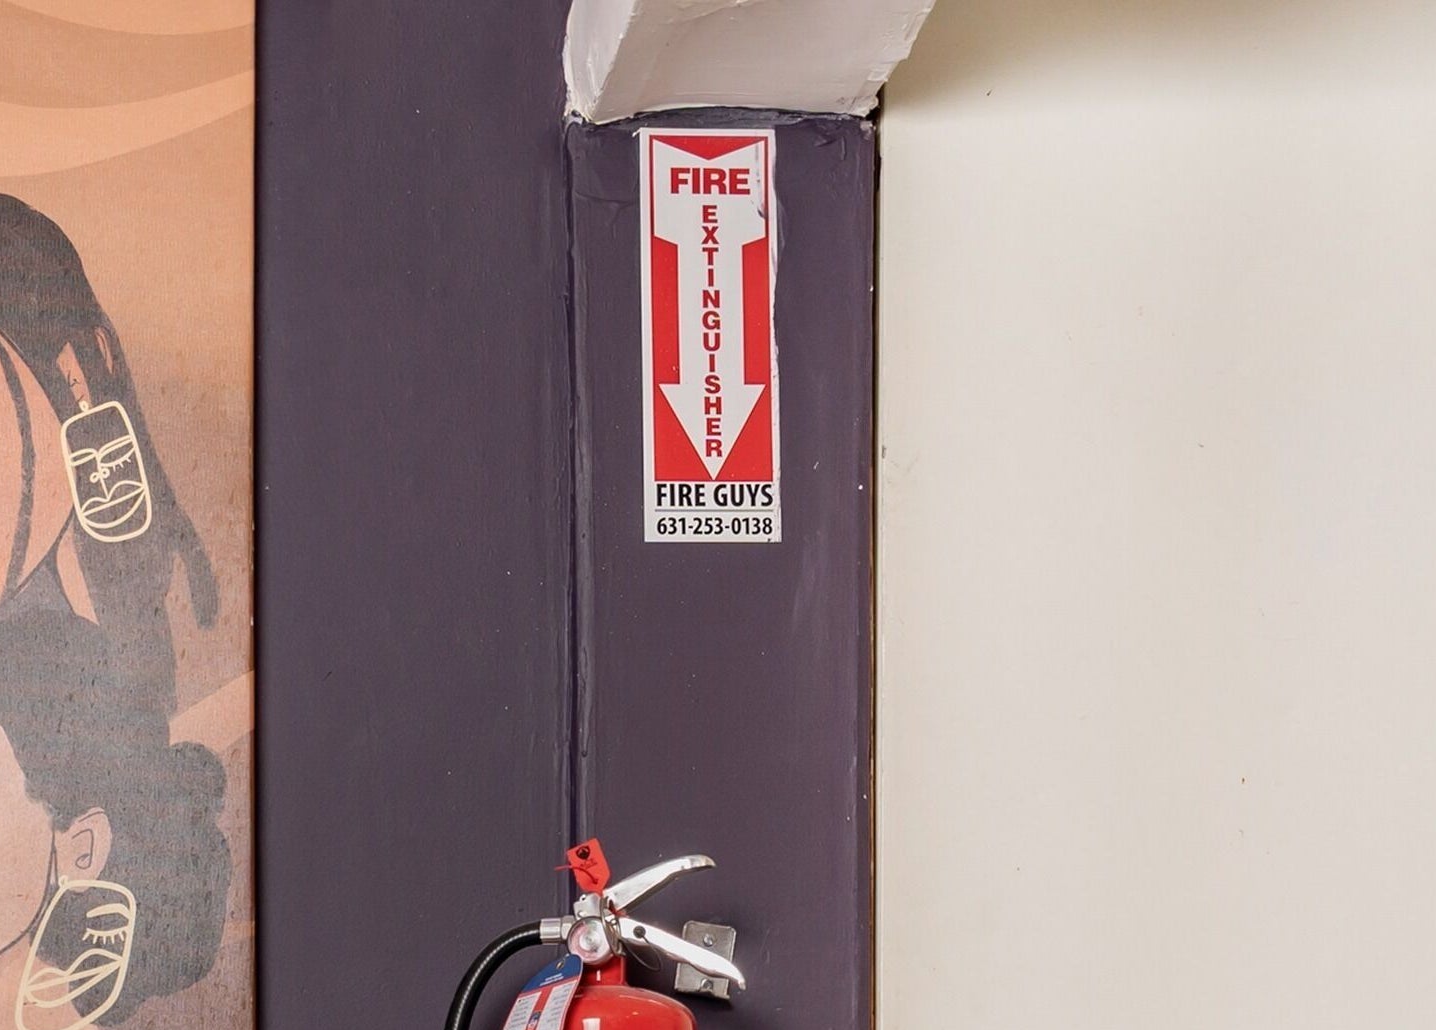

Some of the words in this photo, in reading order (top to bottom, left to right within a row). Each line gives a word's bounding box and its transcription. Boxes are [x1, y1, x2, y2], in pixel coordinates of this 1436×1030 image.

[670, 167, 751, 195] FIRE
[701, 204, 723, 458] EXTINGUISHER
[656, 483, 705, 507] FIRE
[713, 482, 773, 507] GUYS
[656, 517, 773, 536] 631-253-0138
